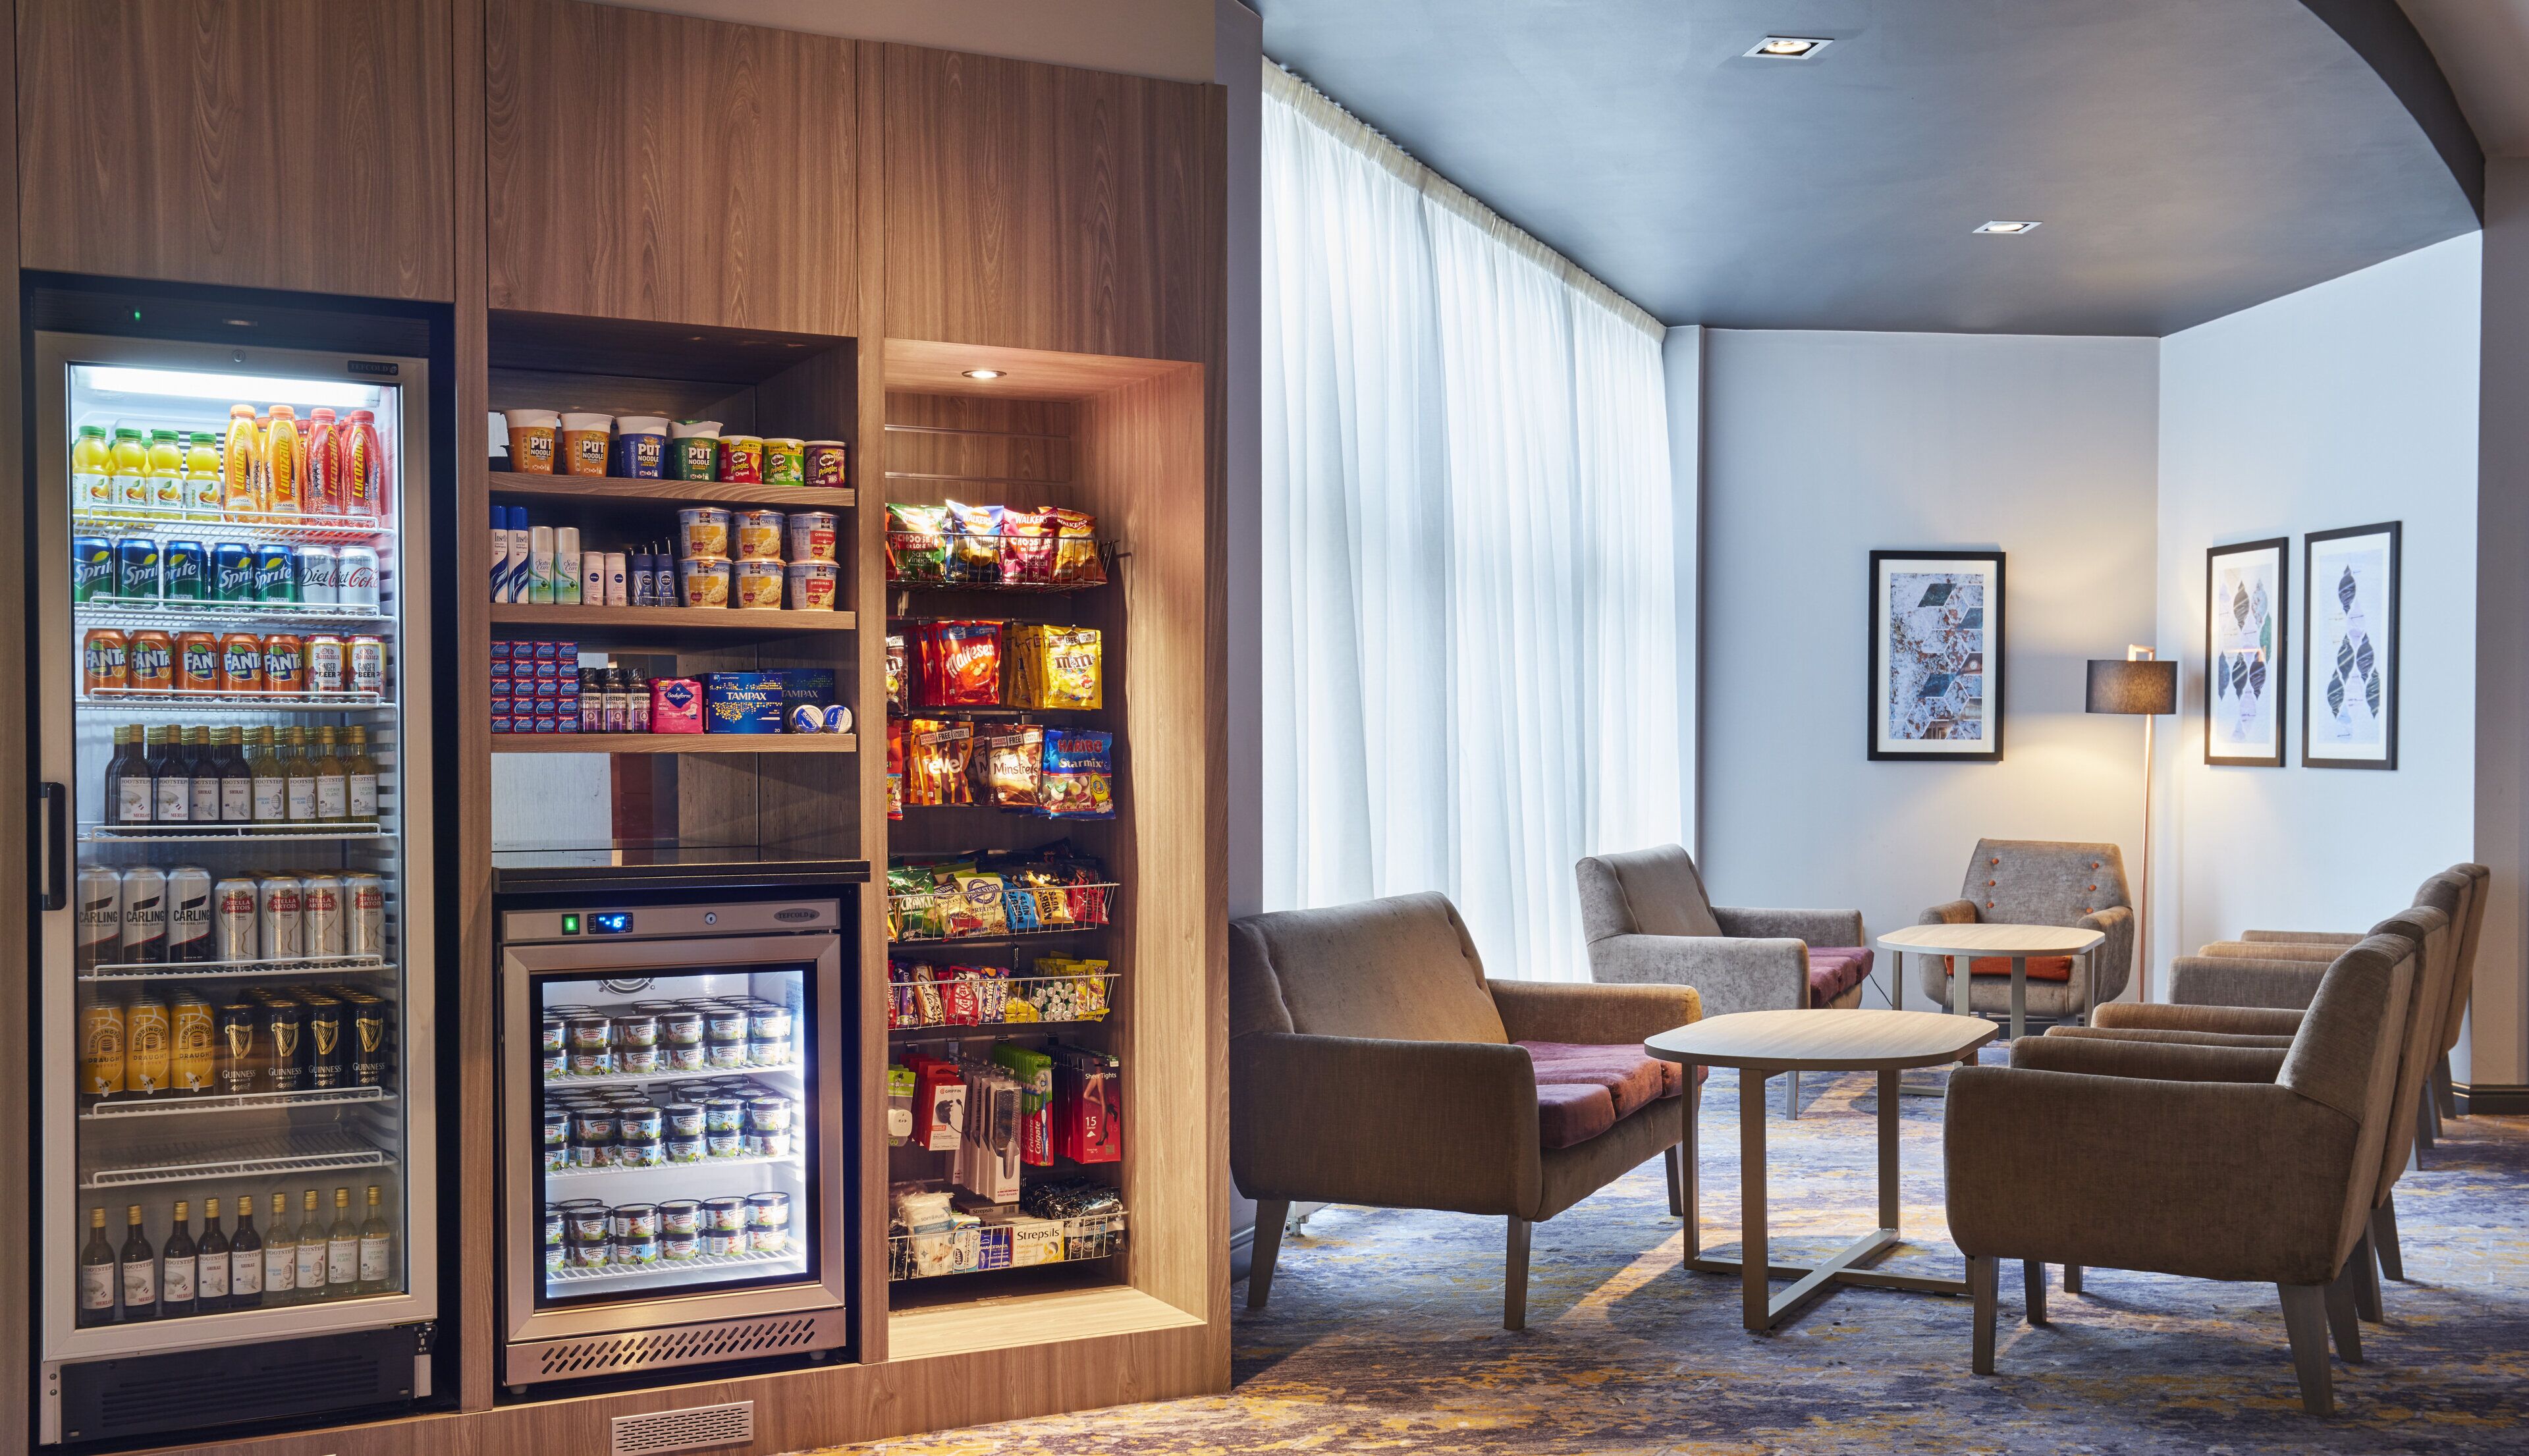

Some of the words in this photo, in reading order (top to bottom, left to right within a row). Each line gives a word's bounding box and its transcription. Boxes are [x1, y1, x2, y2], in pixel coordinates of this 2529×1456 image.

[350, 363, 389, 372] TEFCOLD
[530, 437, 552, 449] POT
[582, 440, 605, 453] POT
[638, 444, 660, 456] POT
[688, 447, 711, 459] POT
[233, 426, 245, 490] Lucozade
[278, 435, 290, 495] Lucozade
[328, 433, 338, 497] Lucozade
[353, 438, 364, 498] Lucozade
[731, 462, 749, 473] Pringles
[771, 465, 788, 474] Pringles
[819, 467, 837, 477] Pringles
[1057, 518, 1087, 529] WALKERS
[254, 565, 291, 590] Sprite
[300, 567, 329, 587] Diet
[348, 567, 379, 588] Coke
[84, 649, 125, 668] FANTA
[132, 650, 170, 669] FANTA
[264, 653, 301, 671] FANTA
[803, 712, 817, 729] Vaseline
[834, 710, 843, 728] Vaseline
[1058, 740, 1102, 753] HARIBO
[994, 762, 1038, 775] Minstrels
[1059, 758, 1102, 768] Starmix
[984, 884, 998, 893] STATE
[79, 911, 118, 923] CARLING
[126, 911, 164, 922] CARLING
[174, 910, 211, 921] CARLING
[269, 1067, 302, 1076] GUINNESS
[309, 1065, 342, 1073] GUINNESS
[352, 1062, 385, 1071] GUINNESS
[223, 1069, 256, 1079] GUINNESS
[1085, 1117, 1097, 1126] 15
[1018, 1228, 1059, 1241] Strepsils
